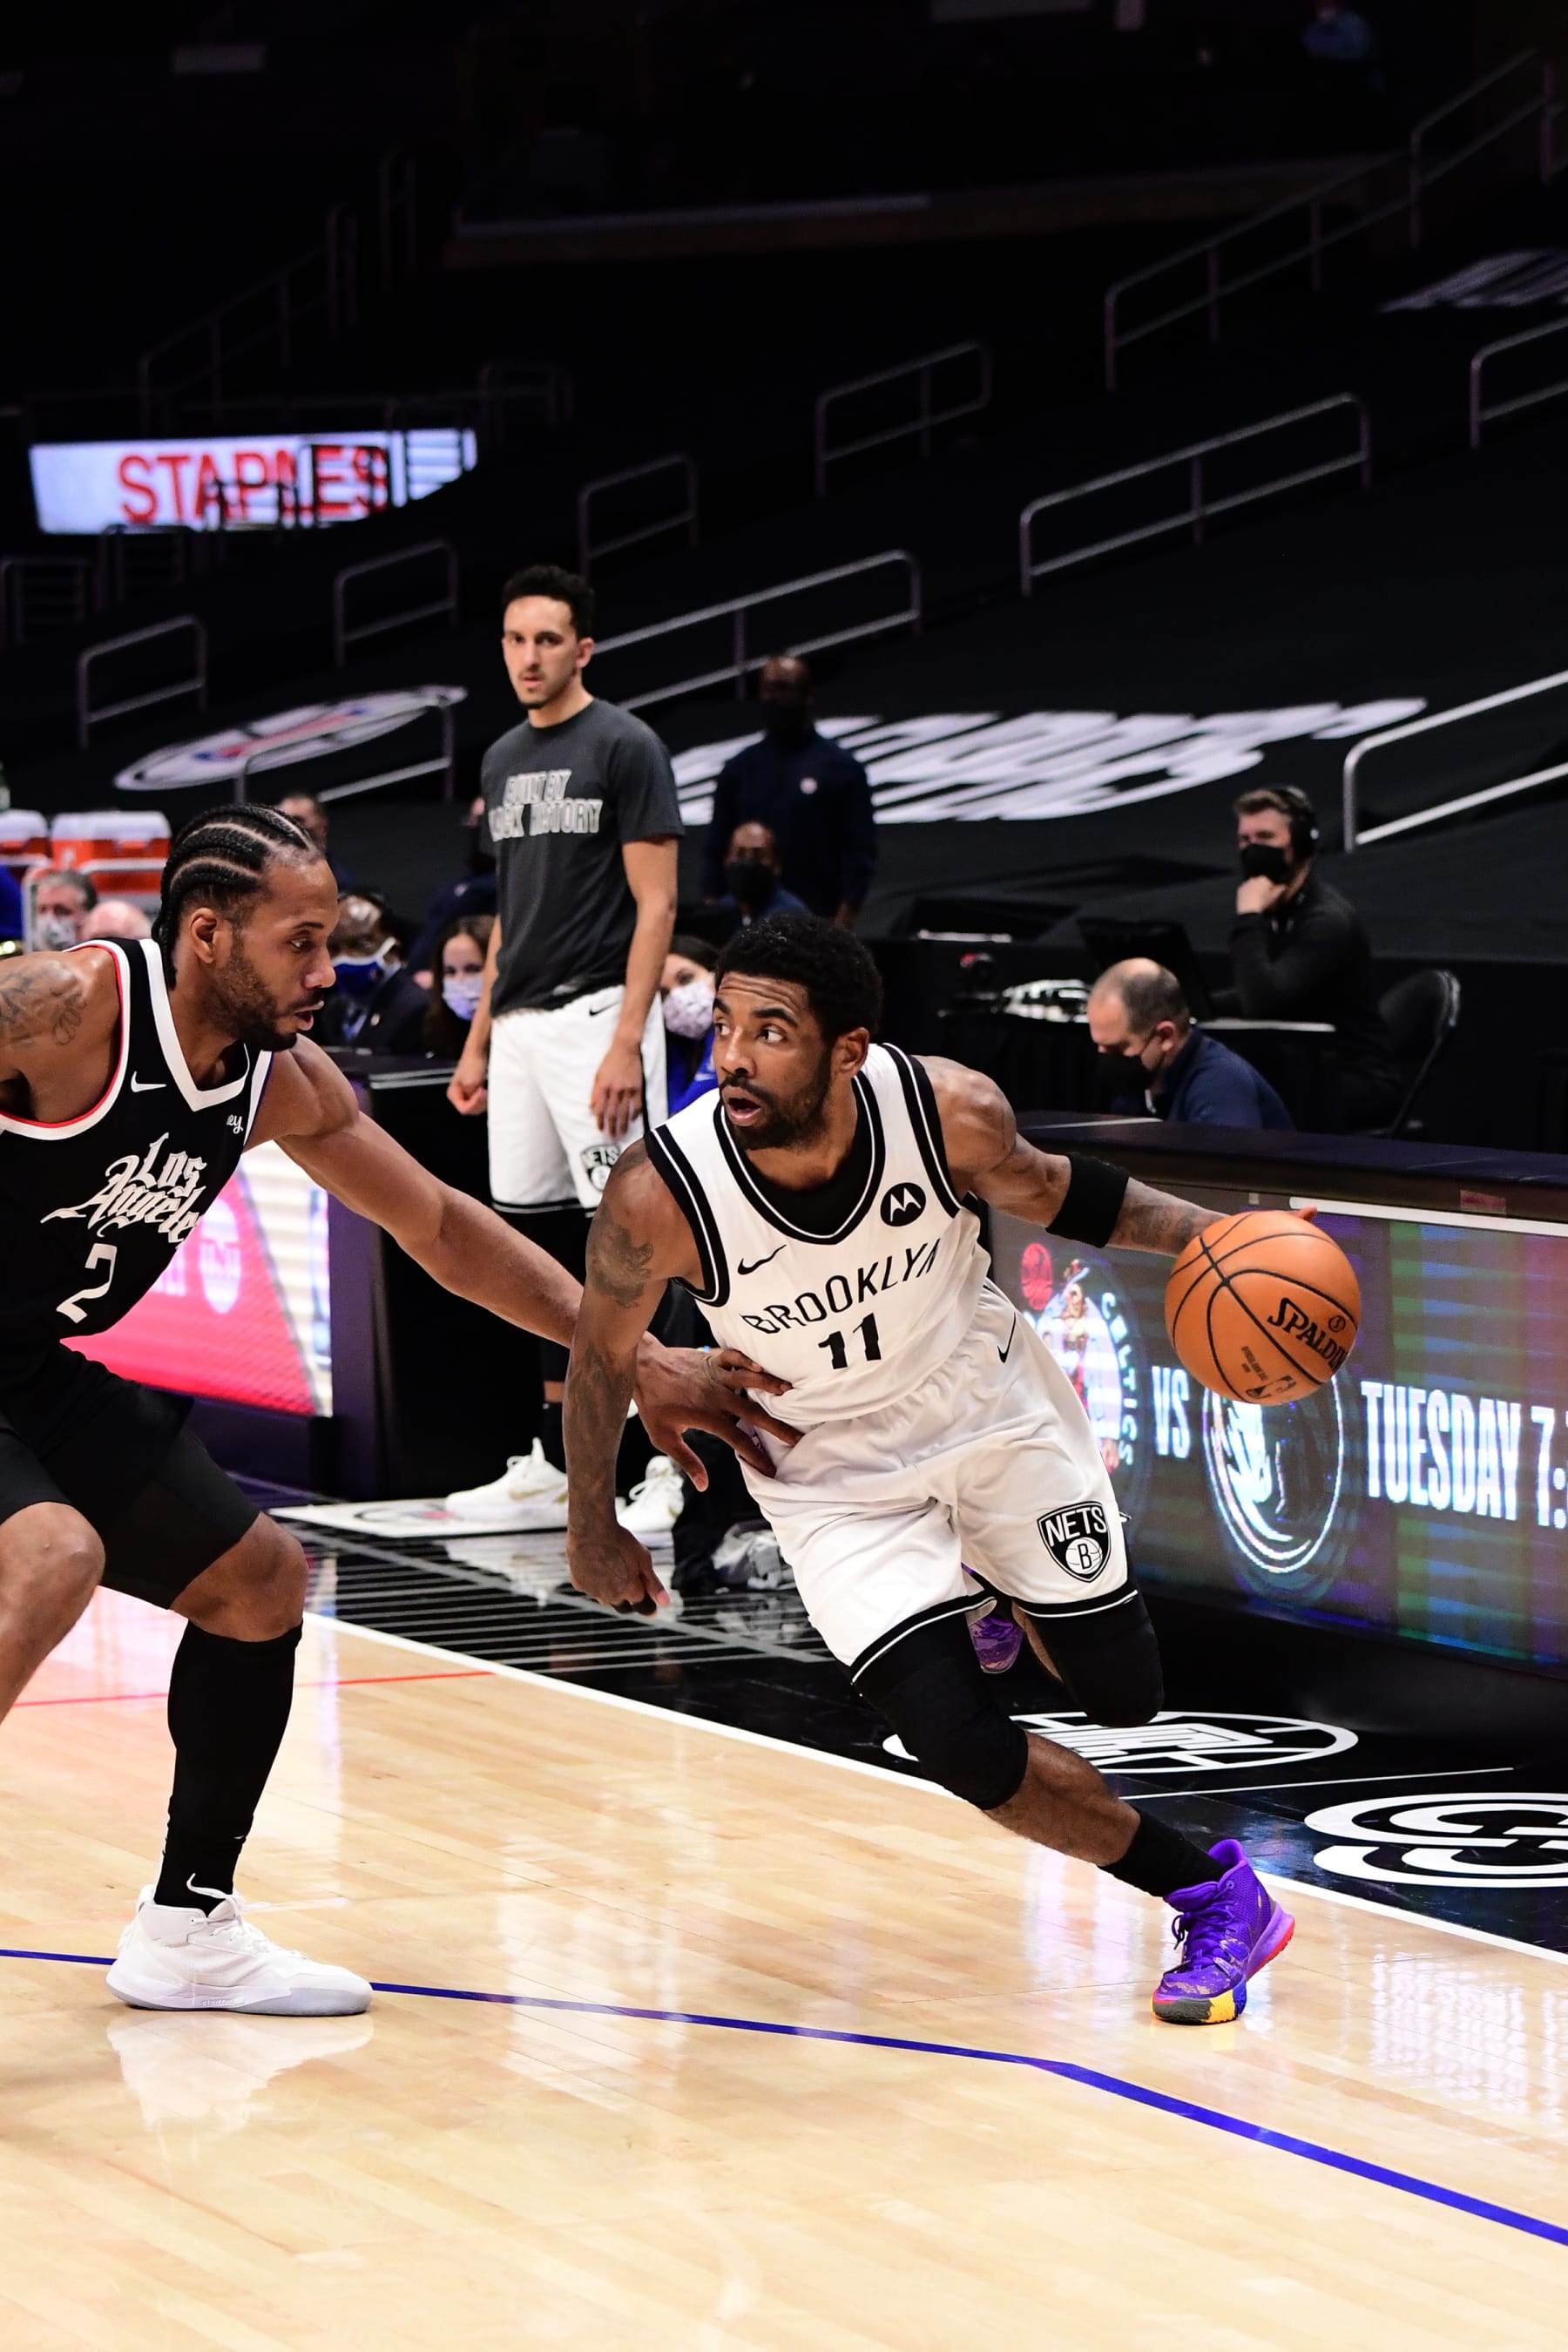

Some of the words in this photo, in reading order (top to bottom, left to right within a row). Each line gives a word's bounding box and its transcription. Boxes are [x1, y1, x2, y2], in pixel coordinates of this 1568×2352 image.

[128, 1132, 207, 1198] Los
[40, 1155, 206, 1249] Angele
[56, 1243, 118, 1323] 2
[739, 1238, 941, 1334] BROOKLYN
[818, 1313, 882, 1370] 11
[1151, 1366, 1191, 1459] VS
[1360, 1380, 1522, 1522] TUESDAY
[1531, 1405, 1568, 1530] 7:
[1044, 1506, 1108, 1547] NETS
[1078, 1543, 1092, 1570] B
